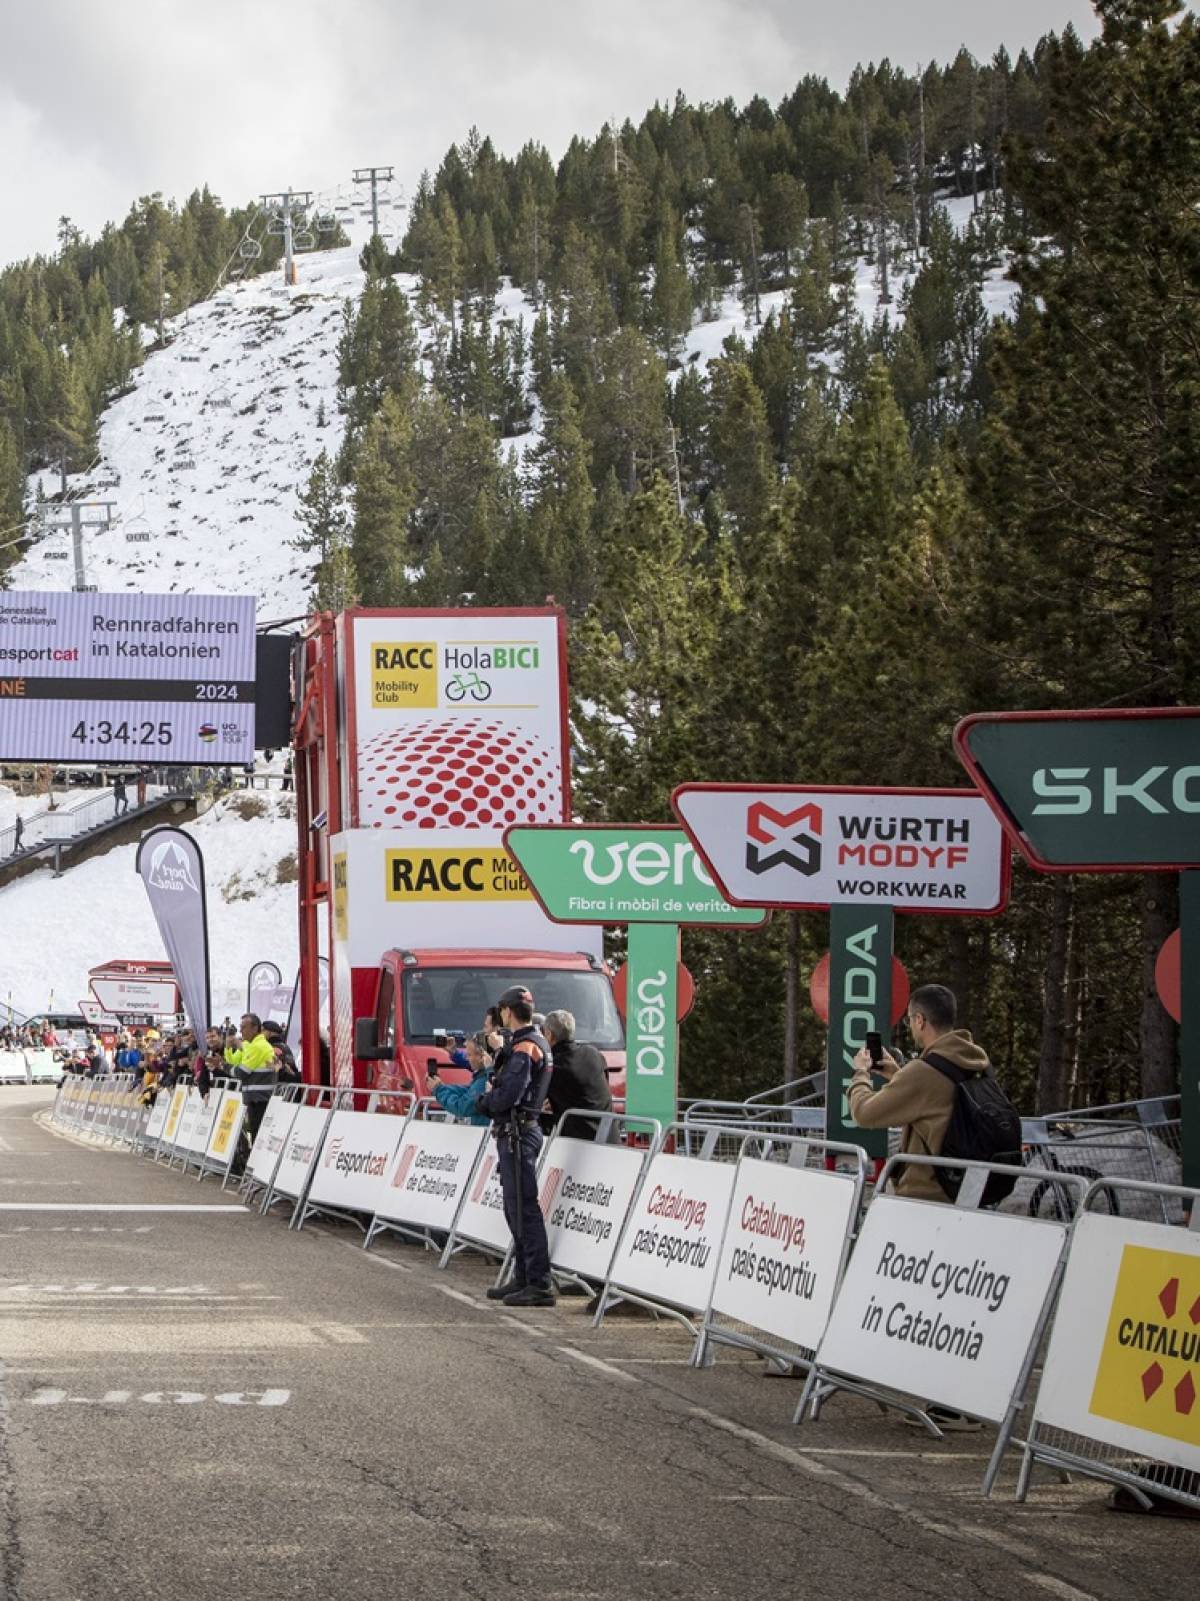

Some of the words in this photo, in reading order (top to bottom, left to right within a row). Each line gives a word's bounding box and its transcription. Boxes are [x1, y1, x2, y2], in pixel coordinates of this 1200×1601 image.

[11, 616, 57, 627] Catalunya
[92, 615, 239, 635] Rennradfahren
[92, 640, 109, 657] in
[116, 641, 220, 659] Katalonien
[375, 648, 433, 670] RACC
[444, 647, 539, 669] HolaBICI
[195, 684, 238, 700] 2024
[375, 681, 419, 693] Mobility
[375, 692, 399, 702] Club
[71, 720, 173, 746] 4:34:25
[838, 816, 969, 842] WÜRTH
[837, 844, 969, 869] MODYF
[392, 858, 484, 892] RACC
[493, 875, 529, 891] Club
[837, 879, 967, 899] WORKWEAR
[569, 897, 605, 911] Fibra
[609, 897, 614, 912] i
[618, 897, 659, 912] mòbil
[663, 898, 682, 912] de
[636, 970, 668, 1076] vera
[335, 1150, 389, 1178] esportcat
[415, 1150, 459, 1173] Generalitat
[406, 1174, 418, 1191] de
[417, 1174, 458, 1202] Catalunya
[561, 1175, 614, 1208] Generalitat
[647, 1184, 707, 1231] Catalunya,
[551, 1207, 565, 1226] de
[564, 1207, 614, 1241] Catalunya
[740, 1195, 807, 1256] Catalunya,
[656, 1231, 712, 1269] esportiu
[756, 1253, 818, 1302] esportiu
[876, 1241, 935, 1286] Road
[932, 1258, 1011, 1312] cycling
[861, 1295, 882, 1332] in
[886, 1302, 984, 1362] Catalonia
